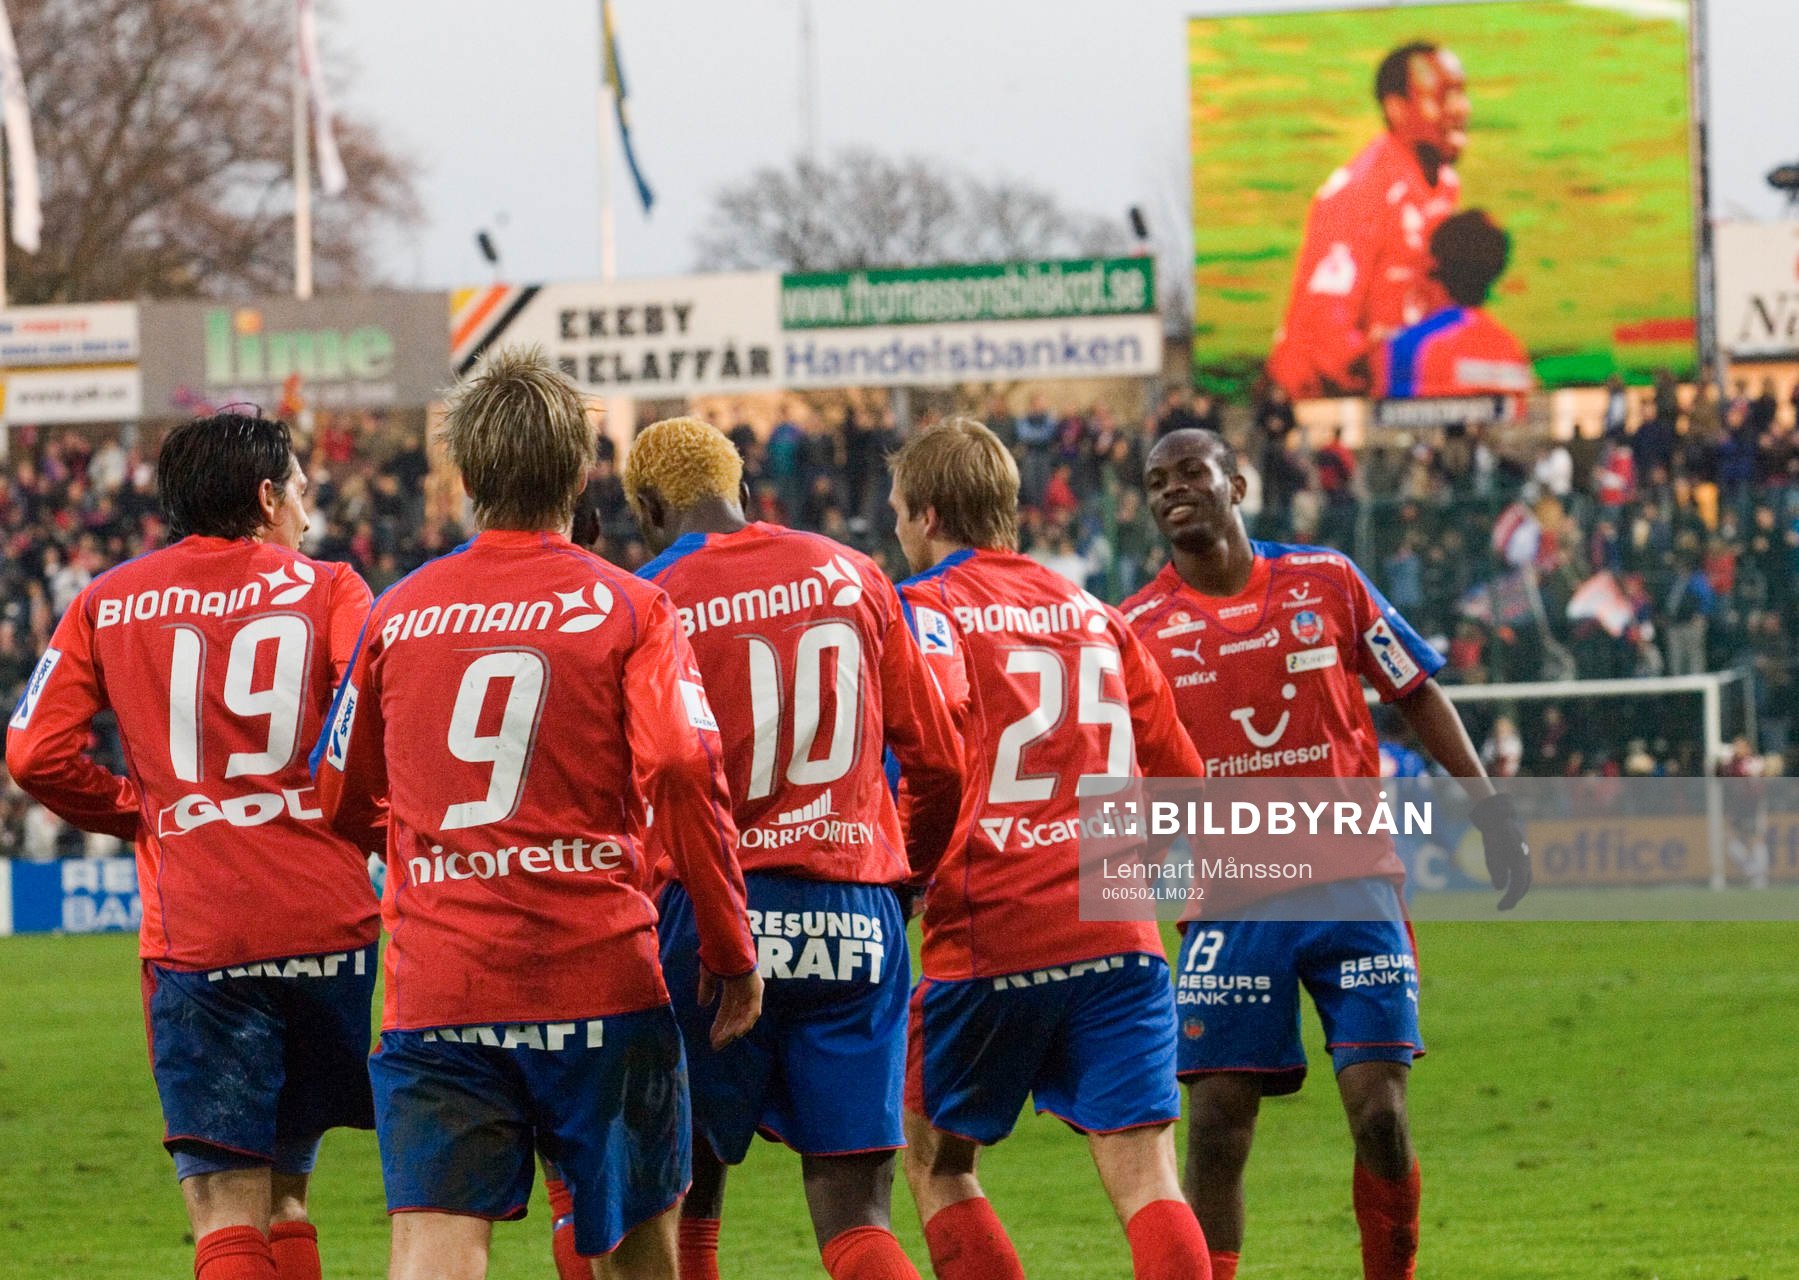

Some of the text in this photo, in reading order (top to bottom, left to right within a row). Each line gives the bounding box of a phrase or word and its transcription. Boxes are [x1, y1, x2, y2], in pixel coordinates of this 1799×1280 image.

[559, 303, 693, 338] EKEBY
[206, 309, 394, 381] lime
[784, 331, 1142, 375] Handelsbanken
[97, 582, 262, 629] BIOMAIN
[382, 601, 554, 649] BIOMAIN
[677, 577, 823, 638] BIOMAIN
[954, 602, 1081, 634] BIOMAIN
[170, 615, 310, 783] 19
[340, 696, 356, 737] SPORT
[747, 622, 862, 801] 10
[440, 652, 547, 831] 9
[988, 646, 1133, 804] 25
[1206, 743, 1332, 778] Fritidsresor
[408, 838, 623, 888] nicorette
[1545, 828, 1687, 875] office
[63, 858, 134, 893] RE
[747, 909, 884, 942] RESUNDS
[756, 936, 884, 984] RAFT
[1185, 930, 1225, 973] 13
[1341, 954, 1416, 975] RESUR
[1177, 991, 1229, 1006] BANK
[1178, 974, 1272, 990] RESURS
[1341, 970, 1401, 990] BANK
